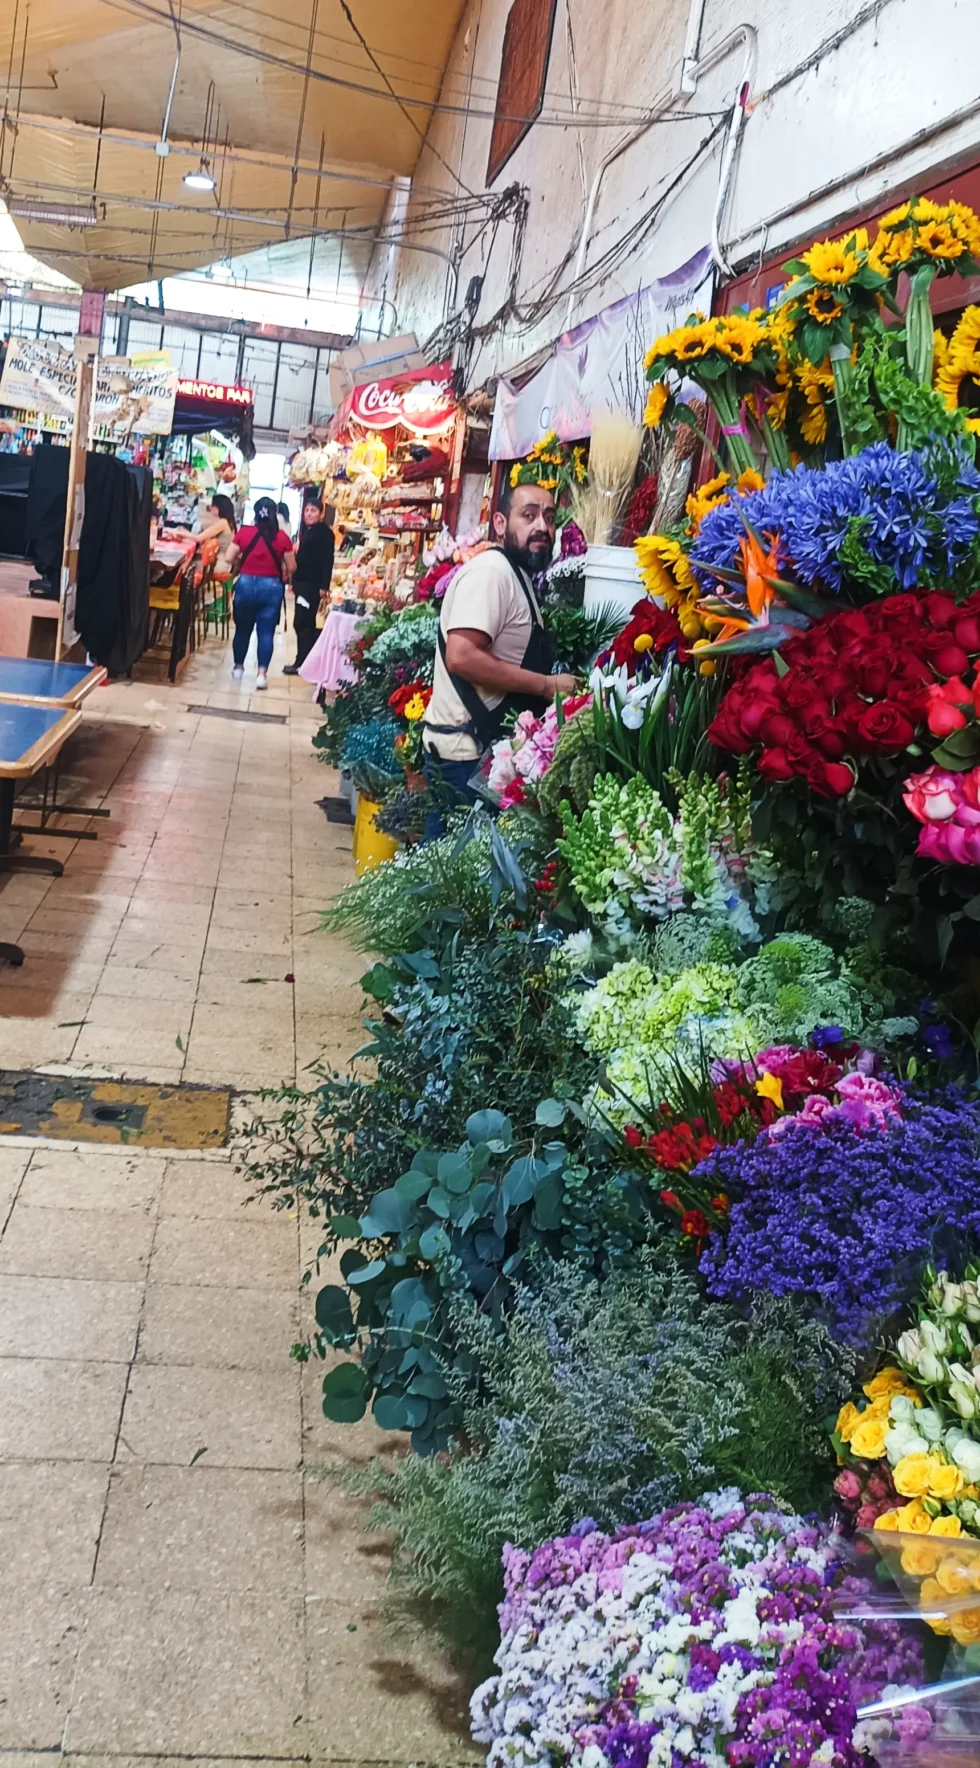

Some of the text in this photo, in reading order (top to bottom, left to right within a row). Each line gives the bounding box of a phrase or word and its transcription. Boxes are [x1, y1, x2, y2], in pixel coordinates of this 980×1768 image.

[8, 357, 35, 373] MOLE
[40, 366, 77, 386] ESPECI
[177, 380, 224, 400] MENTOS
